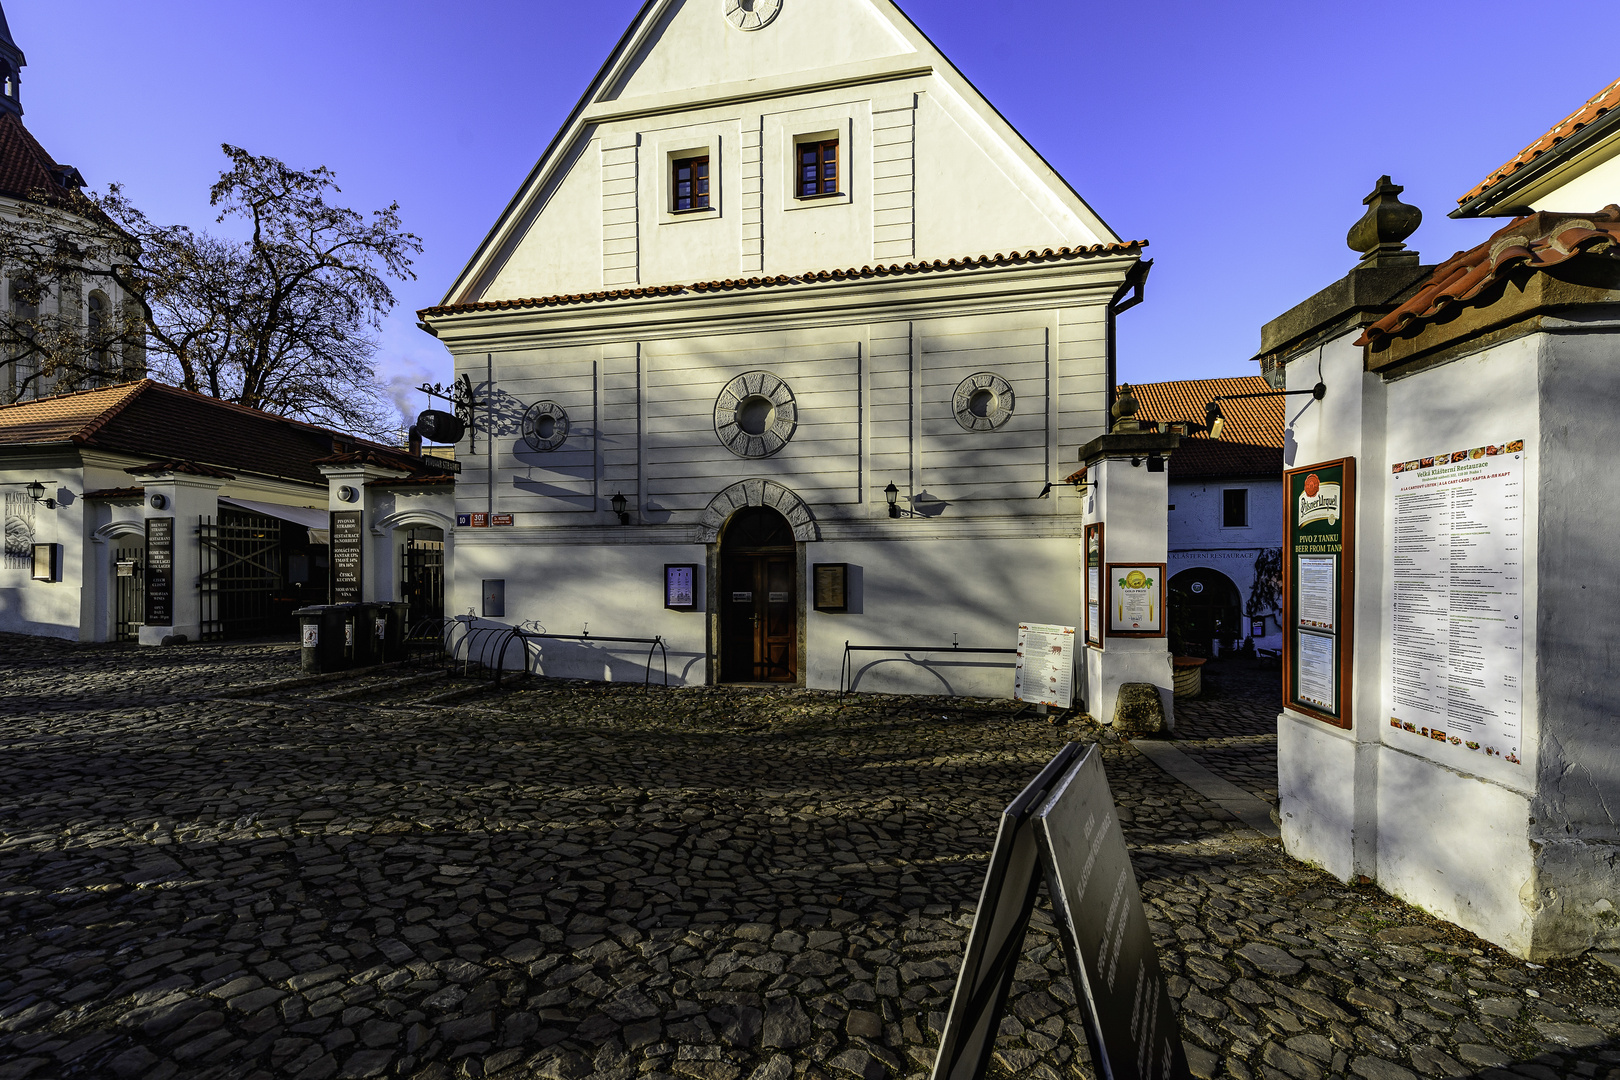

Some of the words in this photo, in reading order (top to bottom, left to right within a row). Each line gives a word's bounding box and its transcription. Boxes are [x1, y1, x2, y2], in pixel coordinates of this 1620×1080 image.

[1456, 462, 1488, 472] Restaurace
[5, 504, 36, 515] PIVOVAR
[1301, 497, 1319, 518] Pilsner
[1318, 494, 1337, 512] Urquell
[1300, 535, 1312, 543] PIVO
[1313, 535, 1318, 543] Z
[1318, 534, 1338, 542] TANKU
[4, 558, 31, 569] STRAHO
[1084, 812, 1095, 840] VELKÁ
[1077, 848, 1094, 902] KLÁŠTERNÍ
[1092, 812, 1111, 855] RESTAURACE
